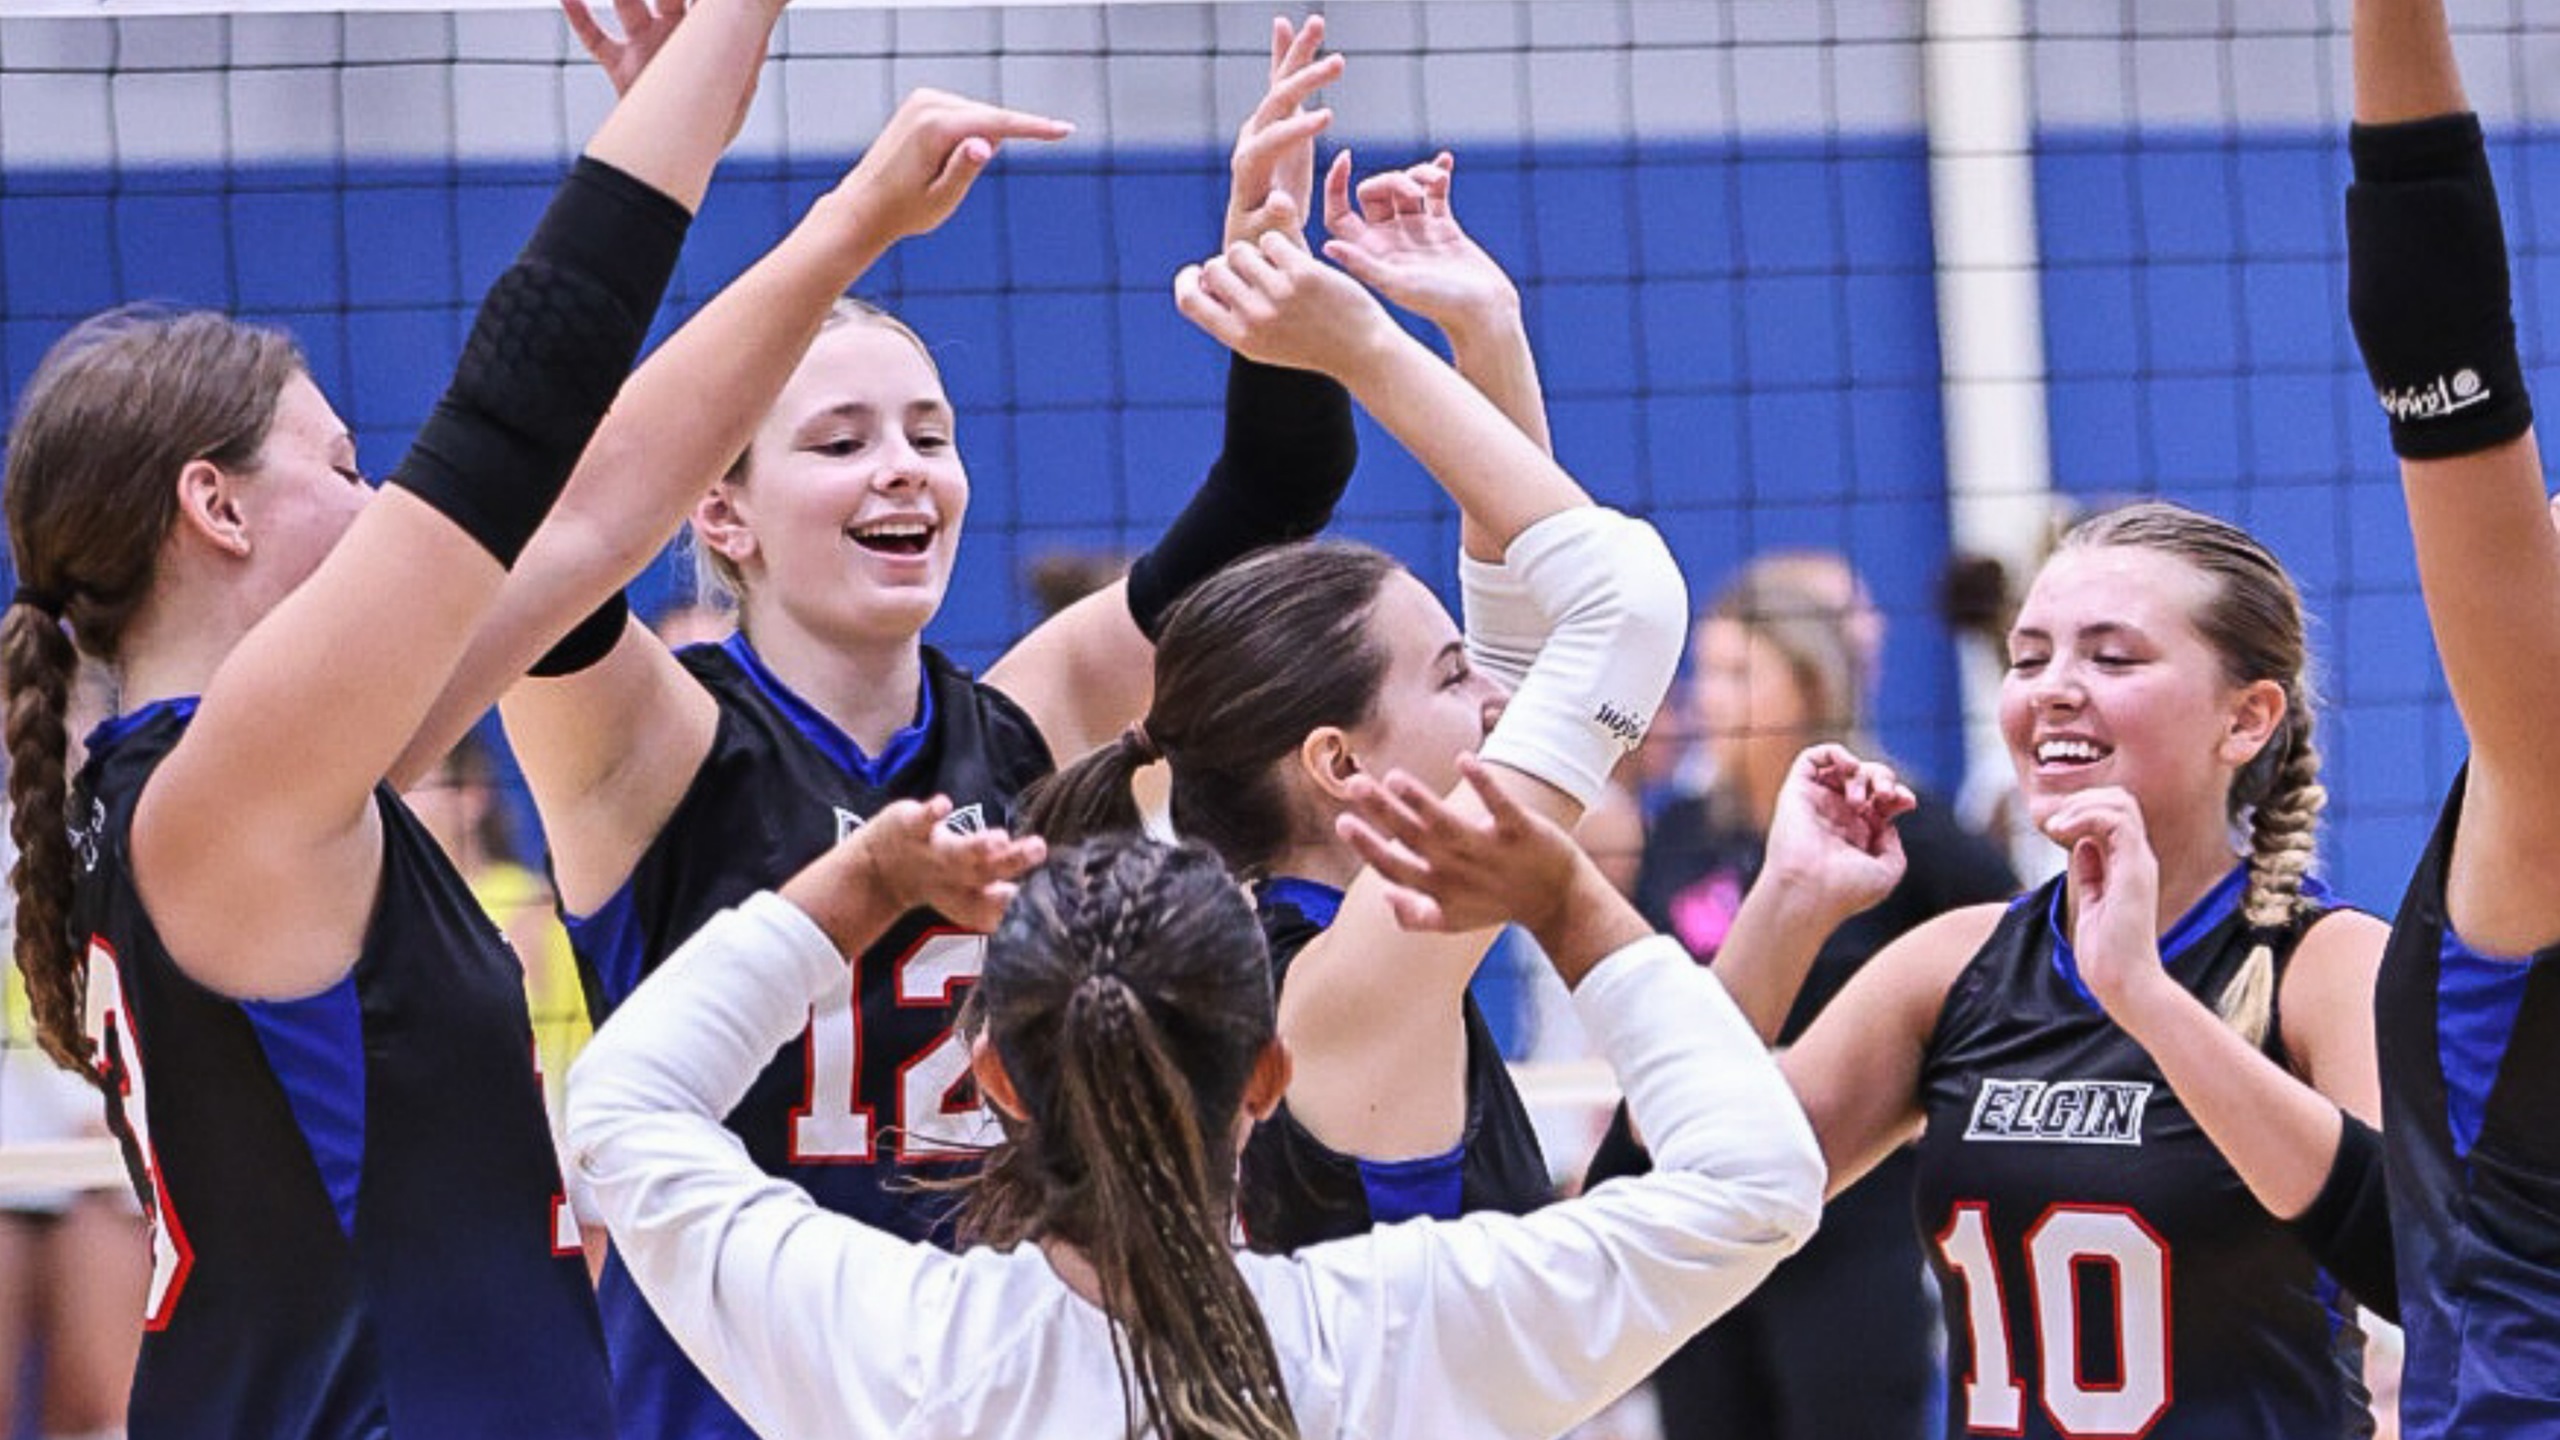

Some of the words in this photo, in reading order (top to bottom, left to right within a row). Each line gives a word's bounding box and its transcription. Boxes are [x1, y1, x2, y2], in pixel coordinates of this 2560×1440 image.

[788, 925, 1008, 1164] 12
[1962, 1078, 2154, 1146] ELGIN
[1934, 1200, 2175, 1440] 10
